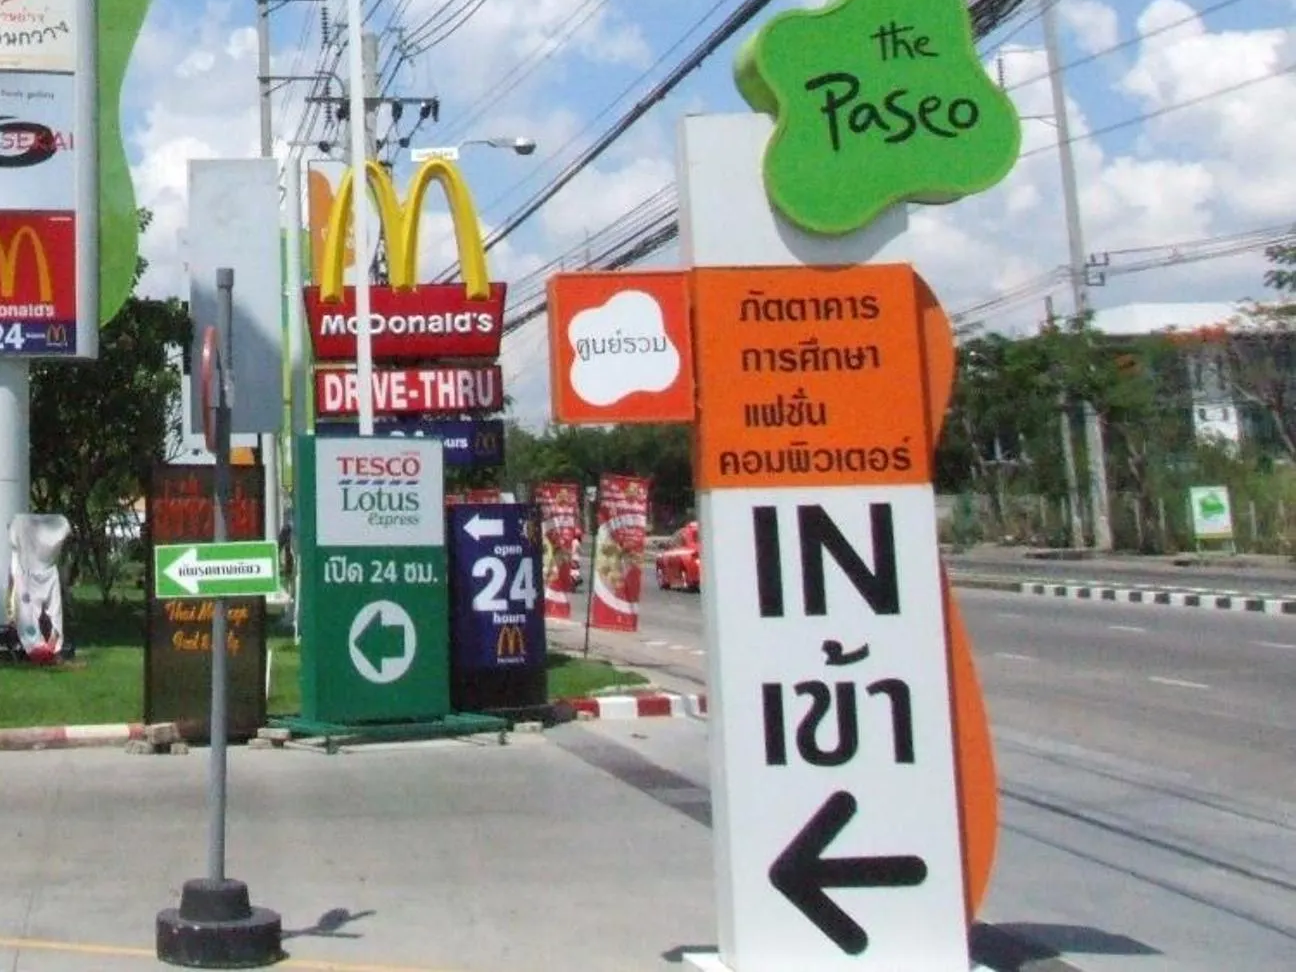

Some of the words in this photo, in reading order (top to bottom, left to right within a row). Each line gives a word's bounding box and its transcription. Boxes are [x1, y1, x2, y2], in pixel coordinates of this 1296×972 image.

[872, 22, 939, 62] the
[805, 72, 979, 151] Paseo
[740, 291, 880, 322] ภัตตาคาร
[320, 312, 494, 336] McDonald's
[576, 328, 667, 361] ศูนย์รวม
[741, 340, 880, 372] การศึกษา
[324, 369, 494, 412] DRVE-THRU
[744, 388, 826, 427] แฟชั่น
[336, 455, 420, 477] TESCO
[719, 436, 912, 475] คอมพิวเตอร์
[341, 488, 420, 512] Lotus
[494, 544, 522, 556] open
[753, 503, 900, 617] IN
[324, 556, 364, 583] เปิด
[371, 561, 397, 583] 24
[404, 563, 438, 583] ชม.
[472, 556, 538, 612] 24
[493, 612, 526, 624] hours
[762, 639, 915, 767] เข้า
